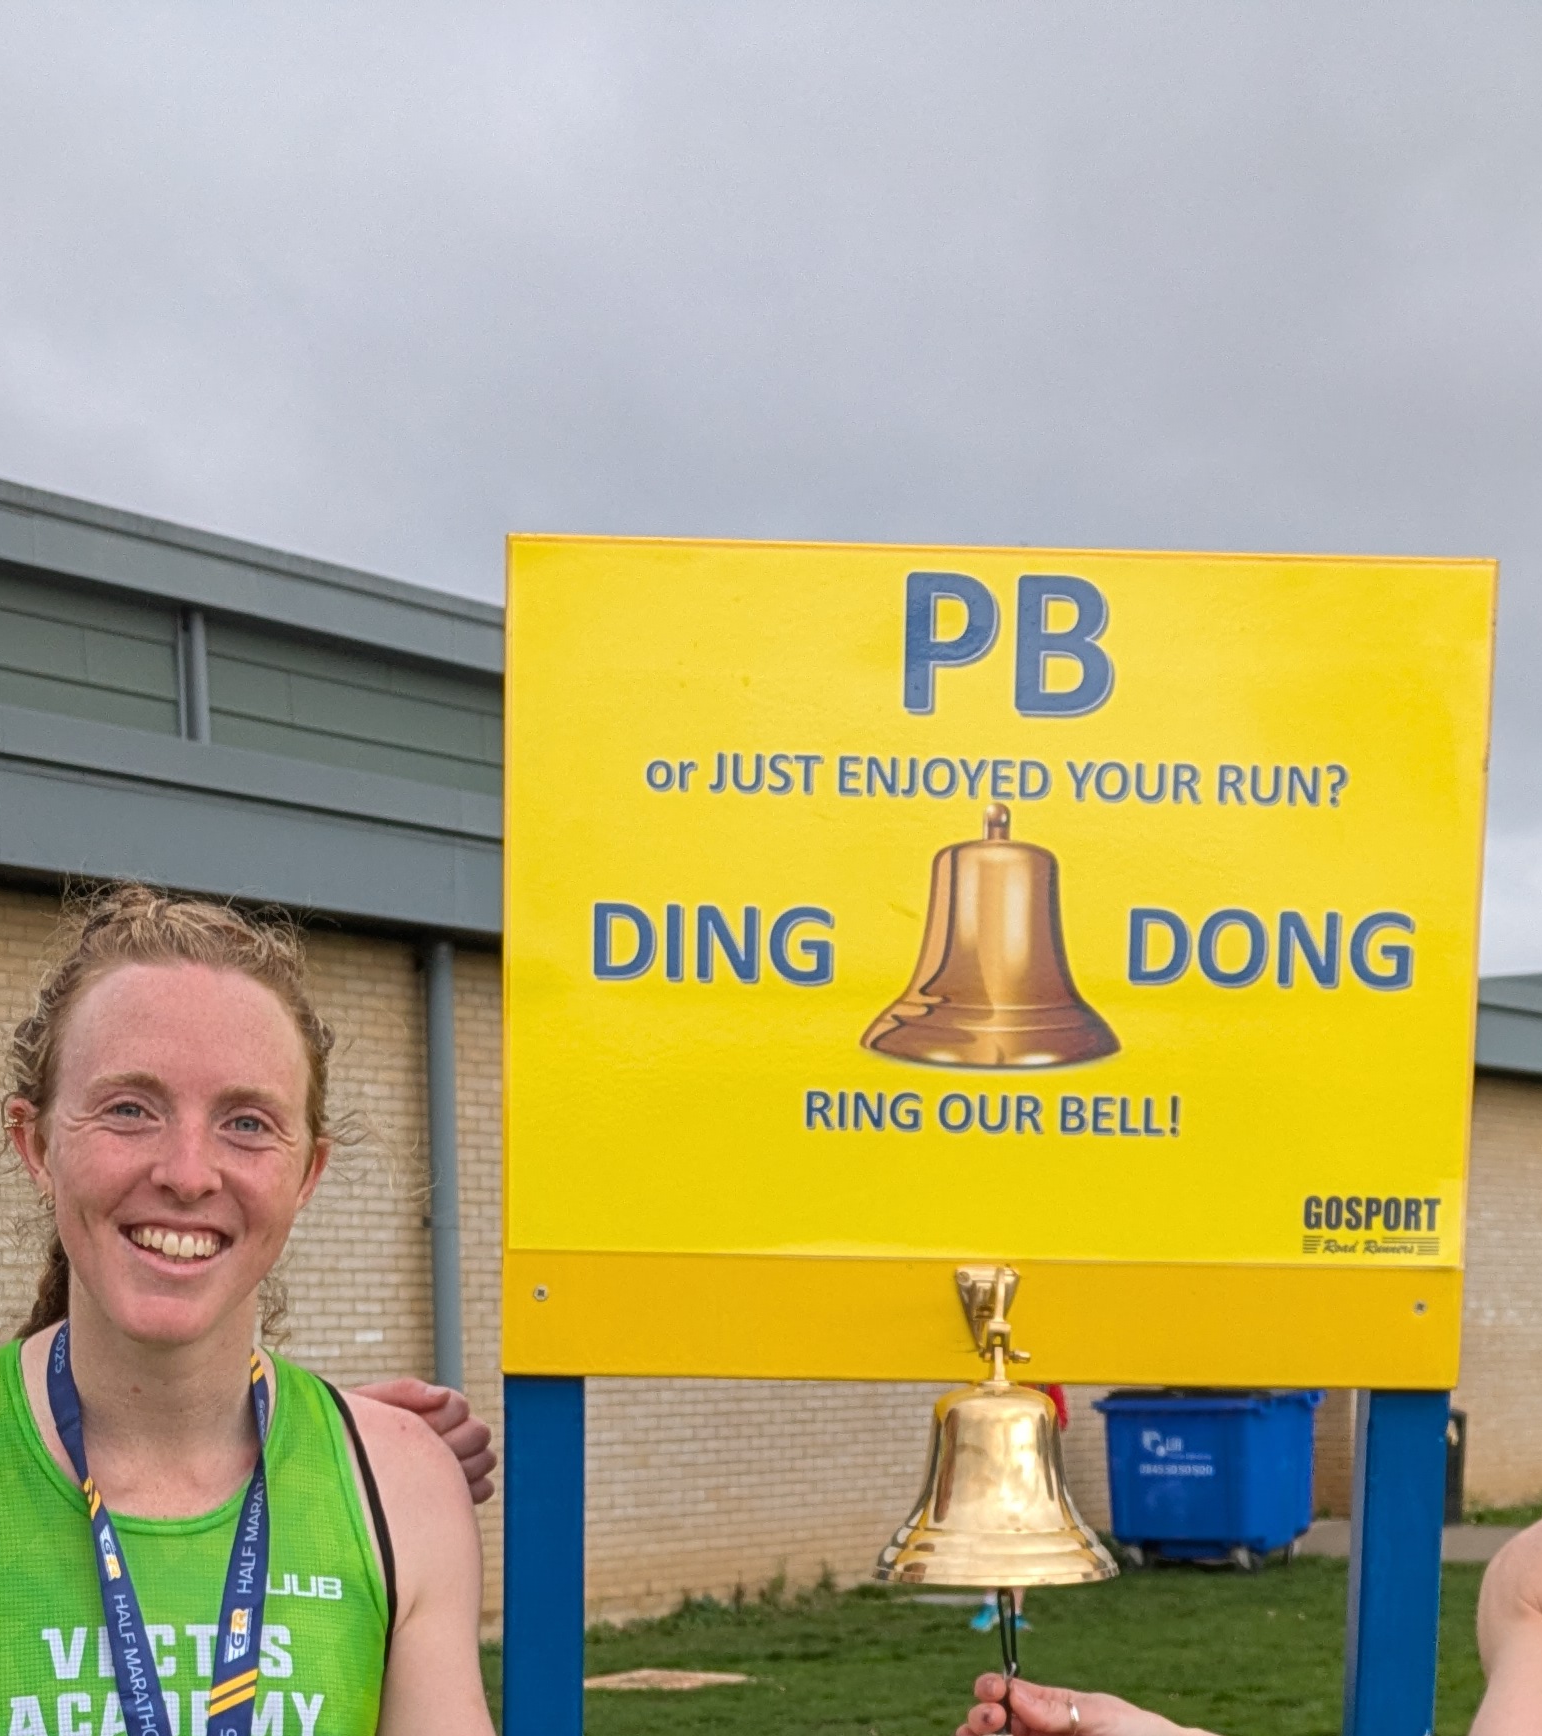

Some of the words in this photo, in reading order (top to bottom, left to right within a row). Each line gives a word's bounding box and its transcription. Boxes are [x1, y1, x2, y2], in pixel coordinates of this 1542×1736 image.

[902, 571, 1115, 717] PB
[646, 758, 697, 793] or
[709, 753, 823, 794] JUST
[839, 756, 1050, 800] ENJOYED
[1067, 761, 1201, 804] YOUR
[1216, 764, 1348, 806] RUN?
[592, 901, 835, 987] DING
[1129, 908, 1416, 989] DONG
[805, 1090, 921, 1133] RING
[938, 1094, 1041, 1135] OUR
[1059, 1096, 1181, 1138] BELL!
[1304, 1195, 1441, 1231] GOSPORT
[1322, 1239, 1359, 1254] Road
[1363, 1240, 1415, 1255] Runners
[237, 1546, 256, 1594] HALF
[266, 1573, 343, 1600] UUB
[114, 1594, 139, 1649] HALF
